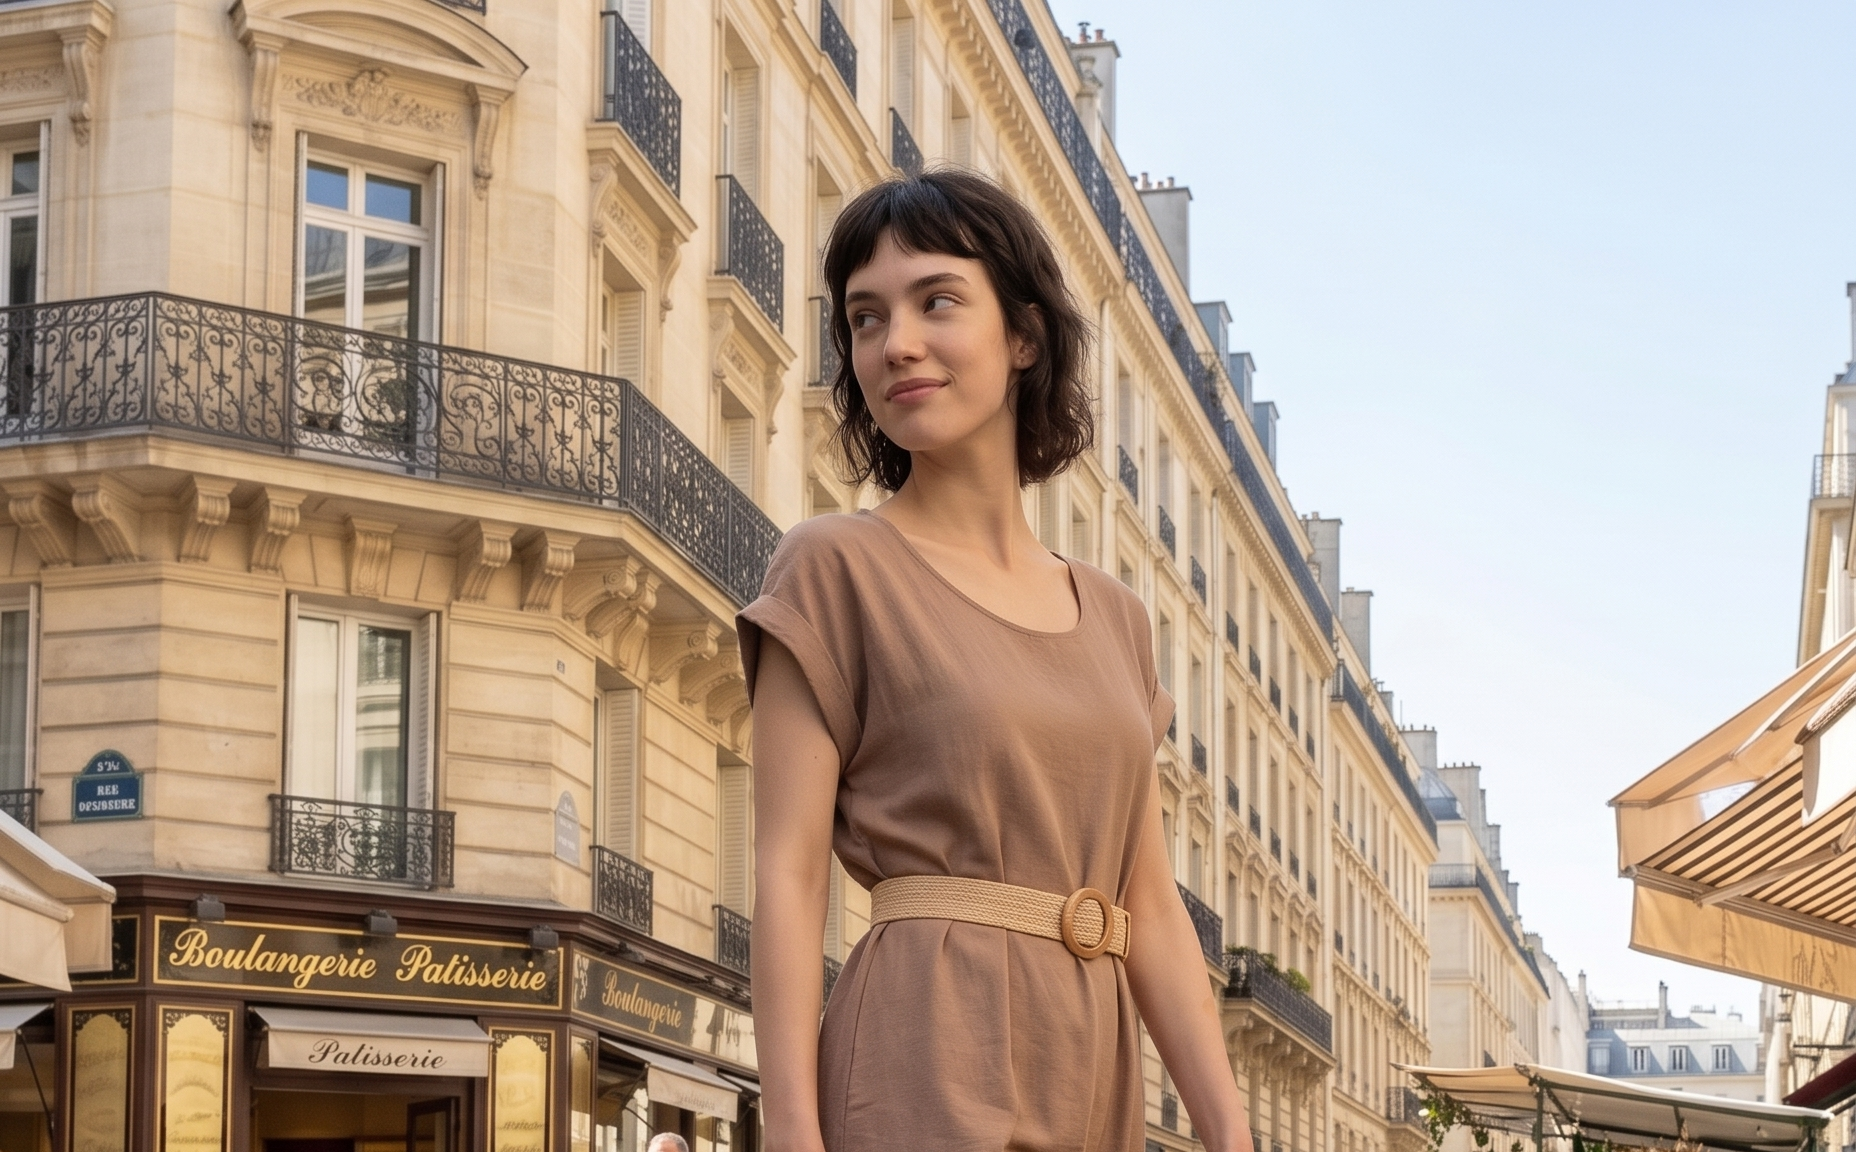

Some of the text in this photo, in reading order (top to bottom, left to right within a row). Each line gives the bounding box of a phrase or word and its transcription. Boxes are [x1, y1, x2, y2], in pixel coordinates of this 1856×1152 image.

[169, 928, 547, 991] Boulangerie Patisserie
[602, 970, 682, 1033] Boulangerie
[308, 1039, 447, 1069] Patisserie
